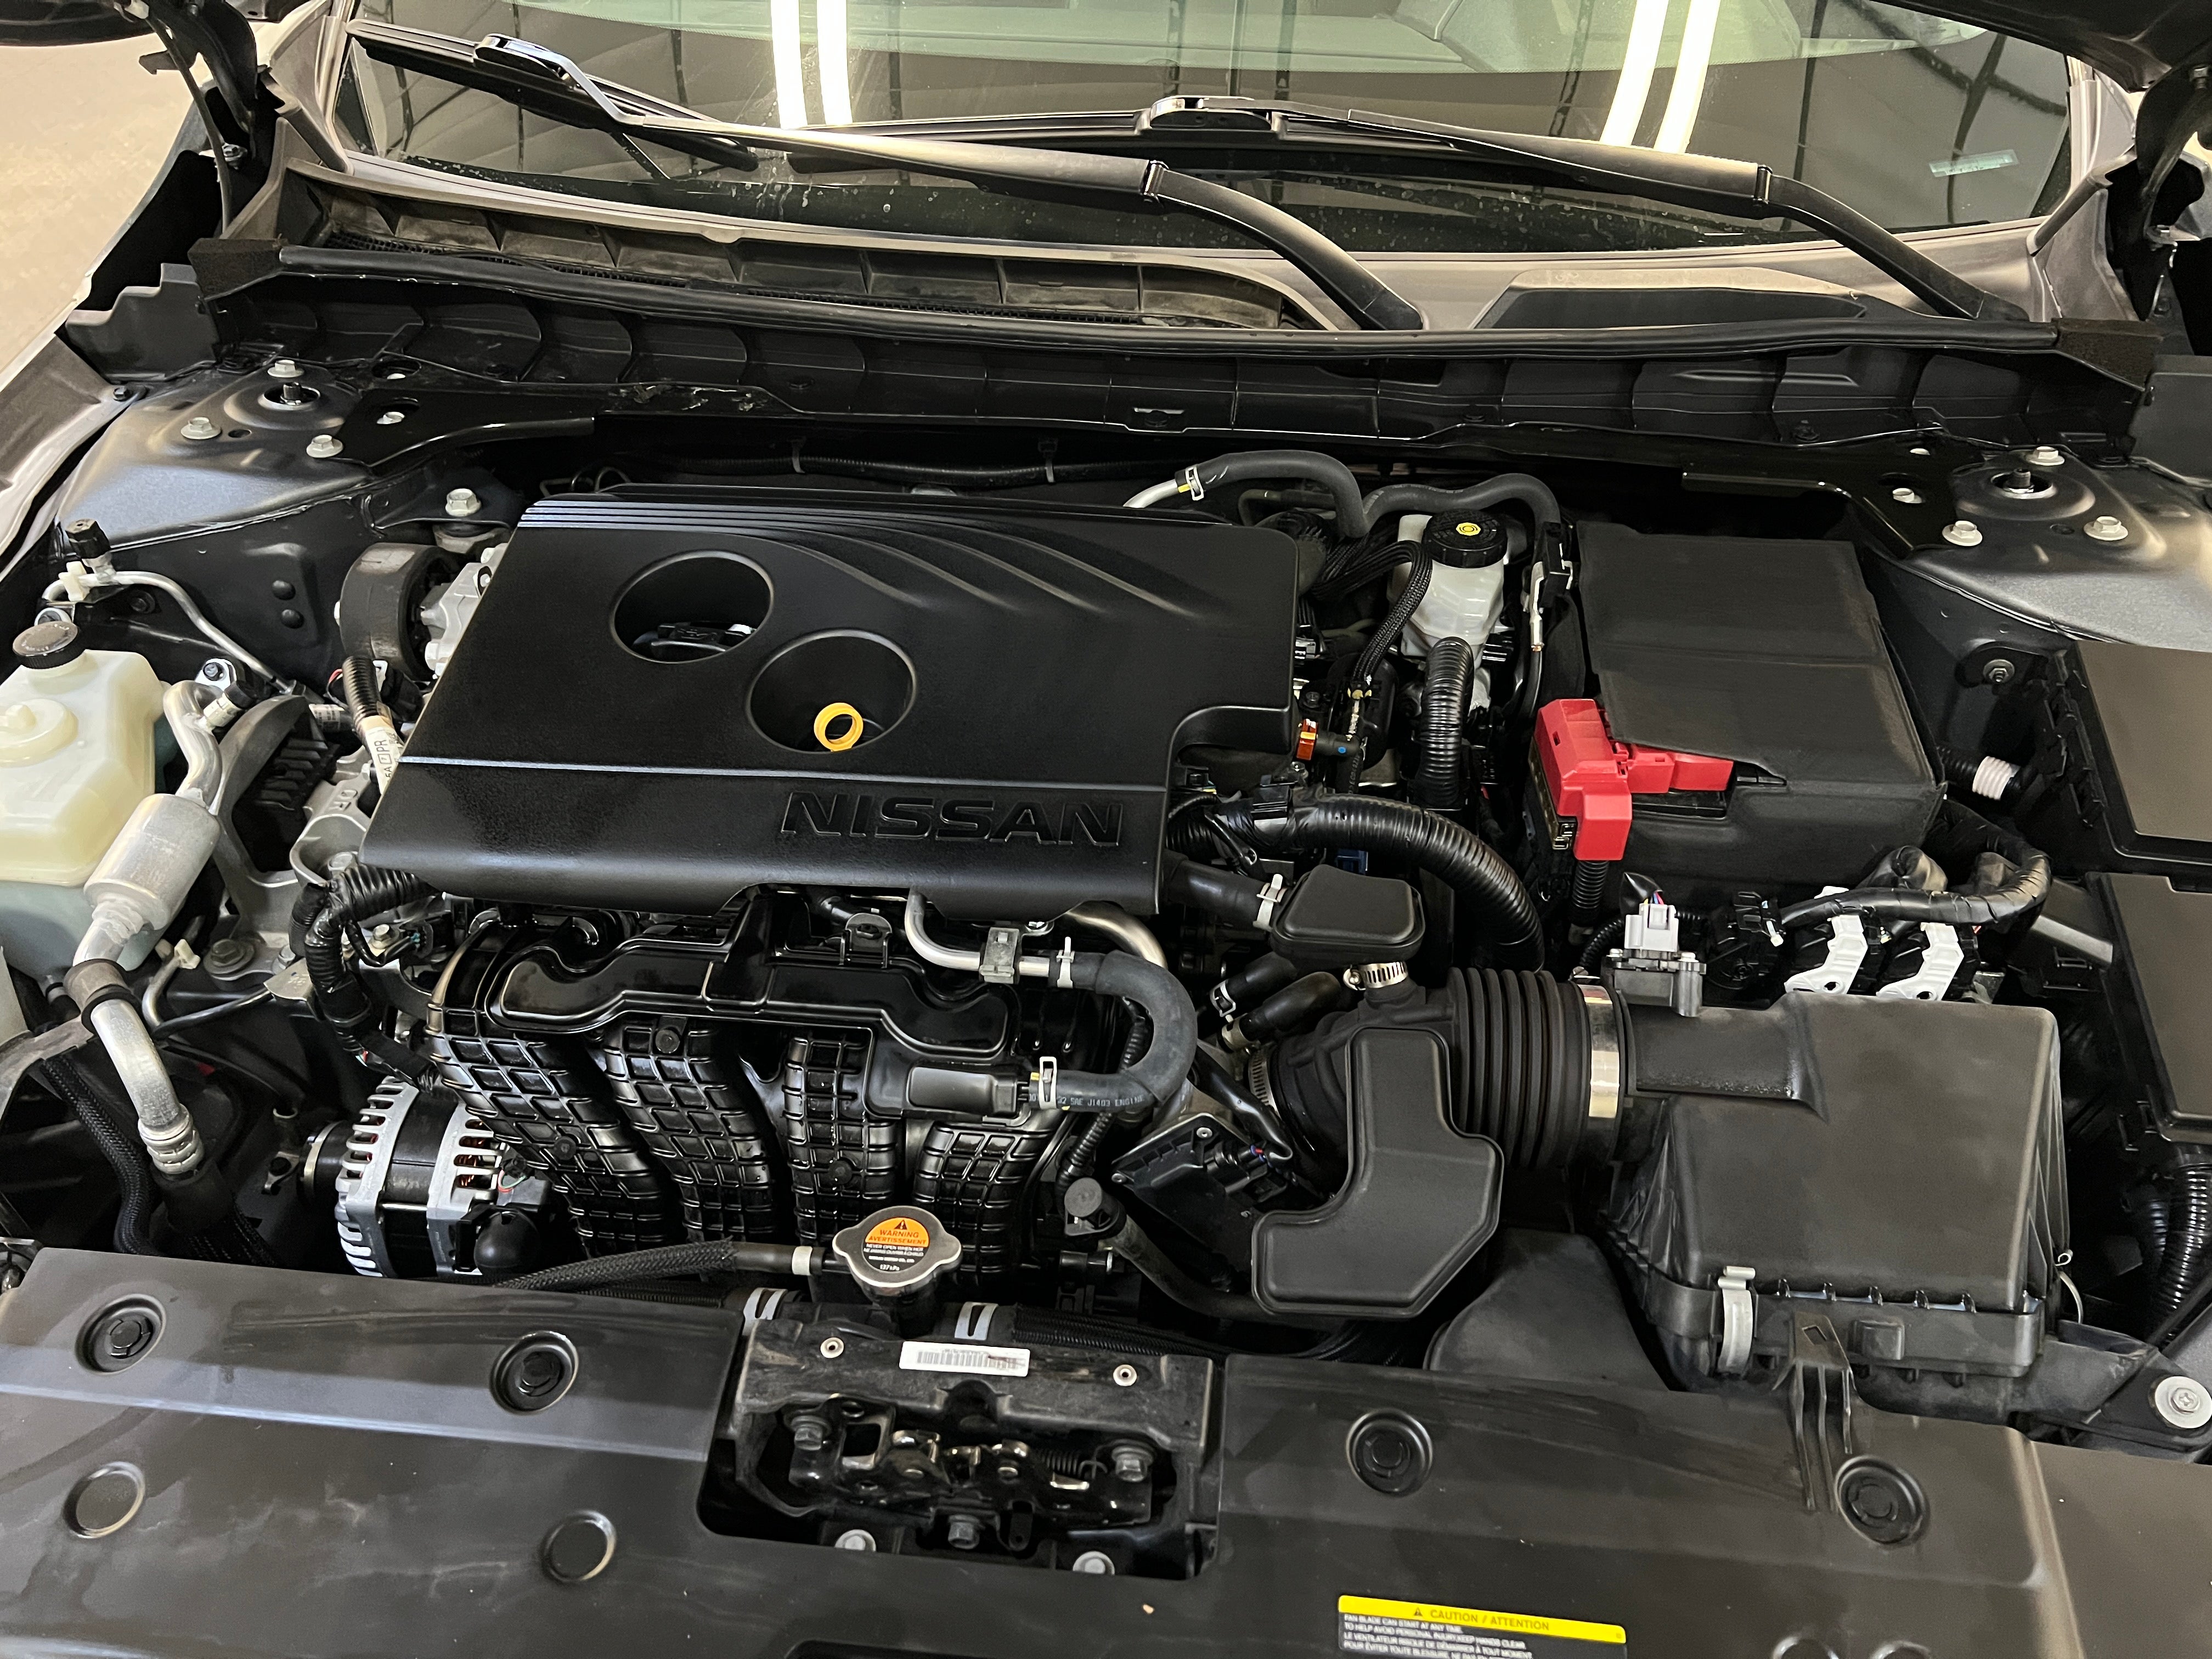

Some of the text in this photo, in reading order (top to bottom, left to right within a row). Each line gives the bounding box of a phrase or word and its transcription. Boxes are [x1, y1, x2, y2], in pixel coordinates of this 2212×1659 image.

[374, 740, 390, 752] PR
[780, 791, 1124, 847] NISSAN
[1070, 1097, 1083, 1106] SAE
[1087, 1099, 1111, 1107] J1403
[1115, 1094, 1145, 1107] ENGINE
[868, 1235, 927, 1245] AVERTISSEMENT
[879, 1229, 919, 1238] WARNING
[1344, 1613, 1358, 1622] FAN
[1382, 1617, 1397, 1626] CAN
[1430, 1623, 1444, 1632] ANY
[1430, 1609, 1479, 1623] CAUTION
[1490, 1616, 1550, 1632] ATTENTION
[1345, 1622, 1354, 1630] TO
[1355, 1623, 1373, 1633] HELP
[1373, 1626, 1396, 1635] AVOID
[1344, 1632, 1353, 1640] LE
[1353, 1633, 1398, 1645] VENTILATEUR
[1425, 1640, 1435, 1649] DE
[1482, 1646, 1500, 1656] TOUT
[1344, 1640, 1364, 1650] POUR
[1389, 1645, 1412, 1655] TOUTE
